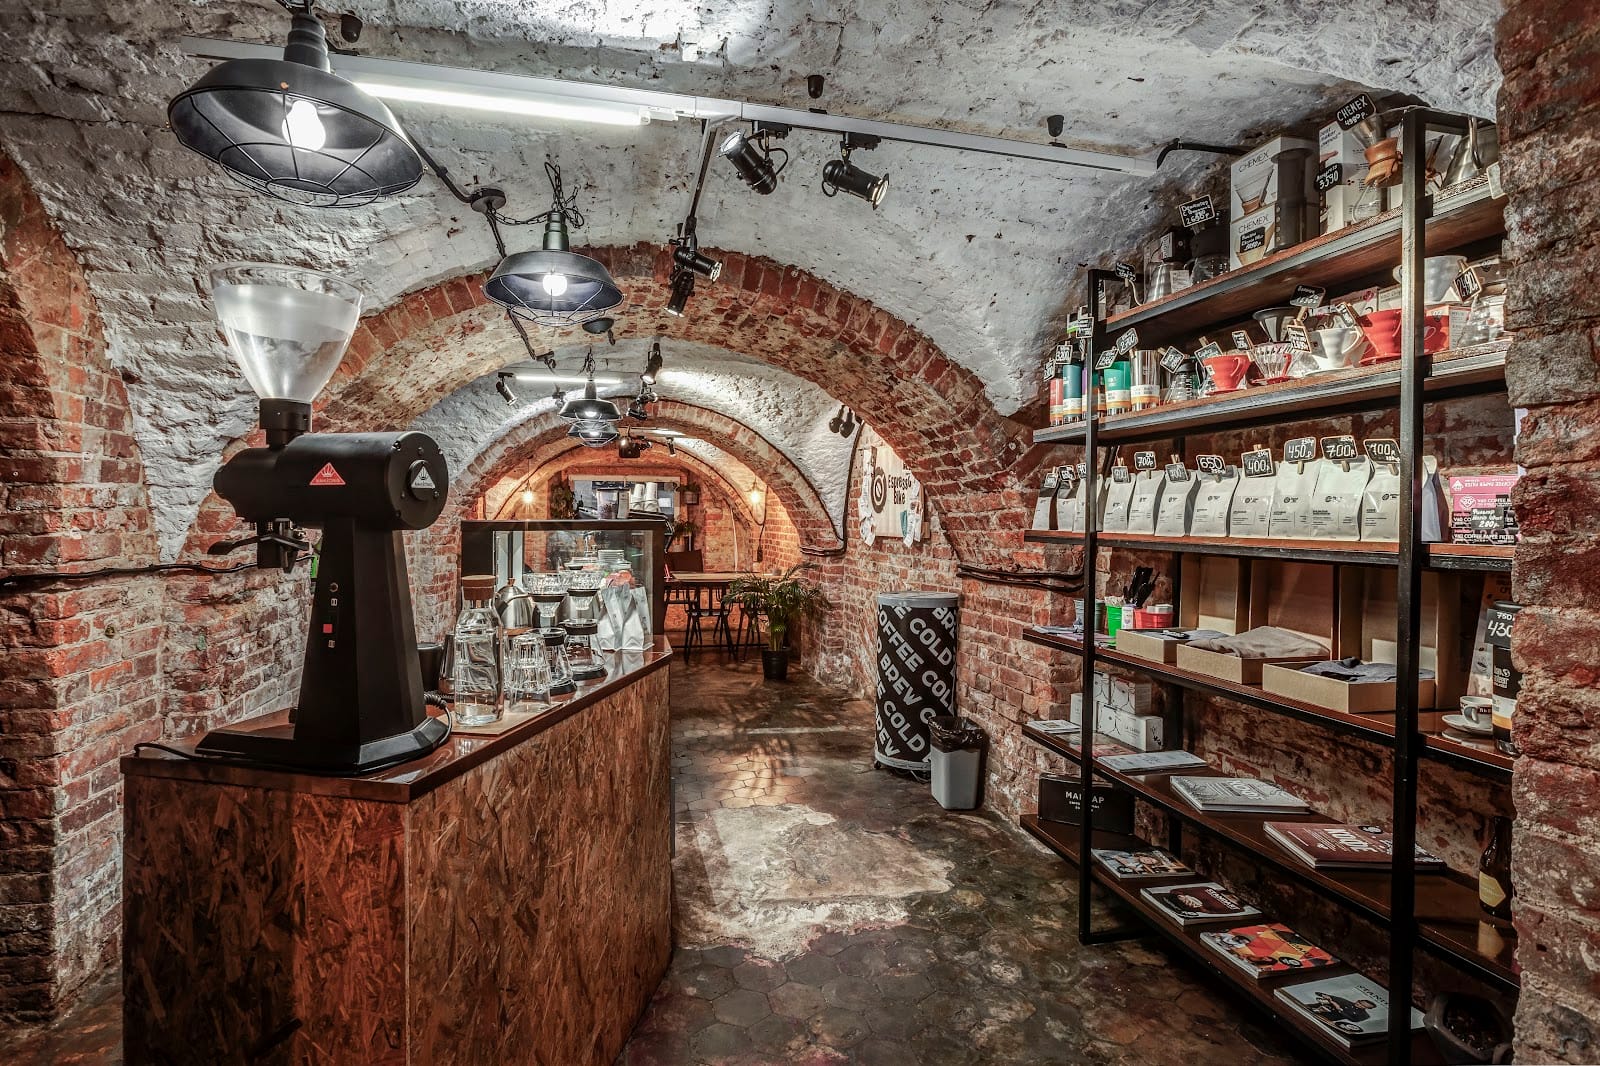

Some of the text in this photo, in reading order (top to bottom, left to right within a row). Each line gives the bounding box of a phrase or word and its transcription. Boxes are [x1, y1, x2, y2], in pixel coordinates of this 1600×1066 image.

[1336, 95, 1368, 121] CHEMEX
[1238, 150, 1269, 172] CHEMEX
[1238, 214, 1269, 233] CHEMEX
[1200, 457, 1223, 470] 650
[878, 609, 924, 673] OFFEE
[910, 617, 952, 666] COLD
[880, 653, 922, 706] BREW
[884, 700, 926, 752] COLD
